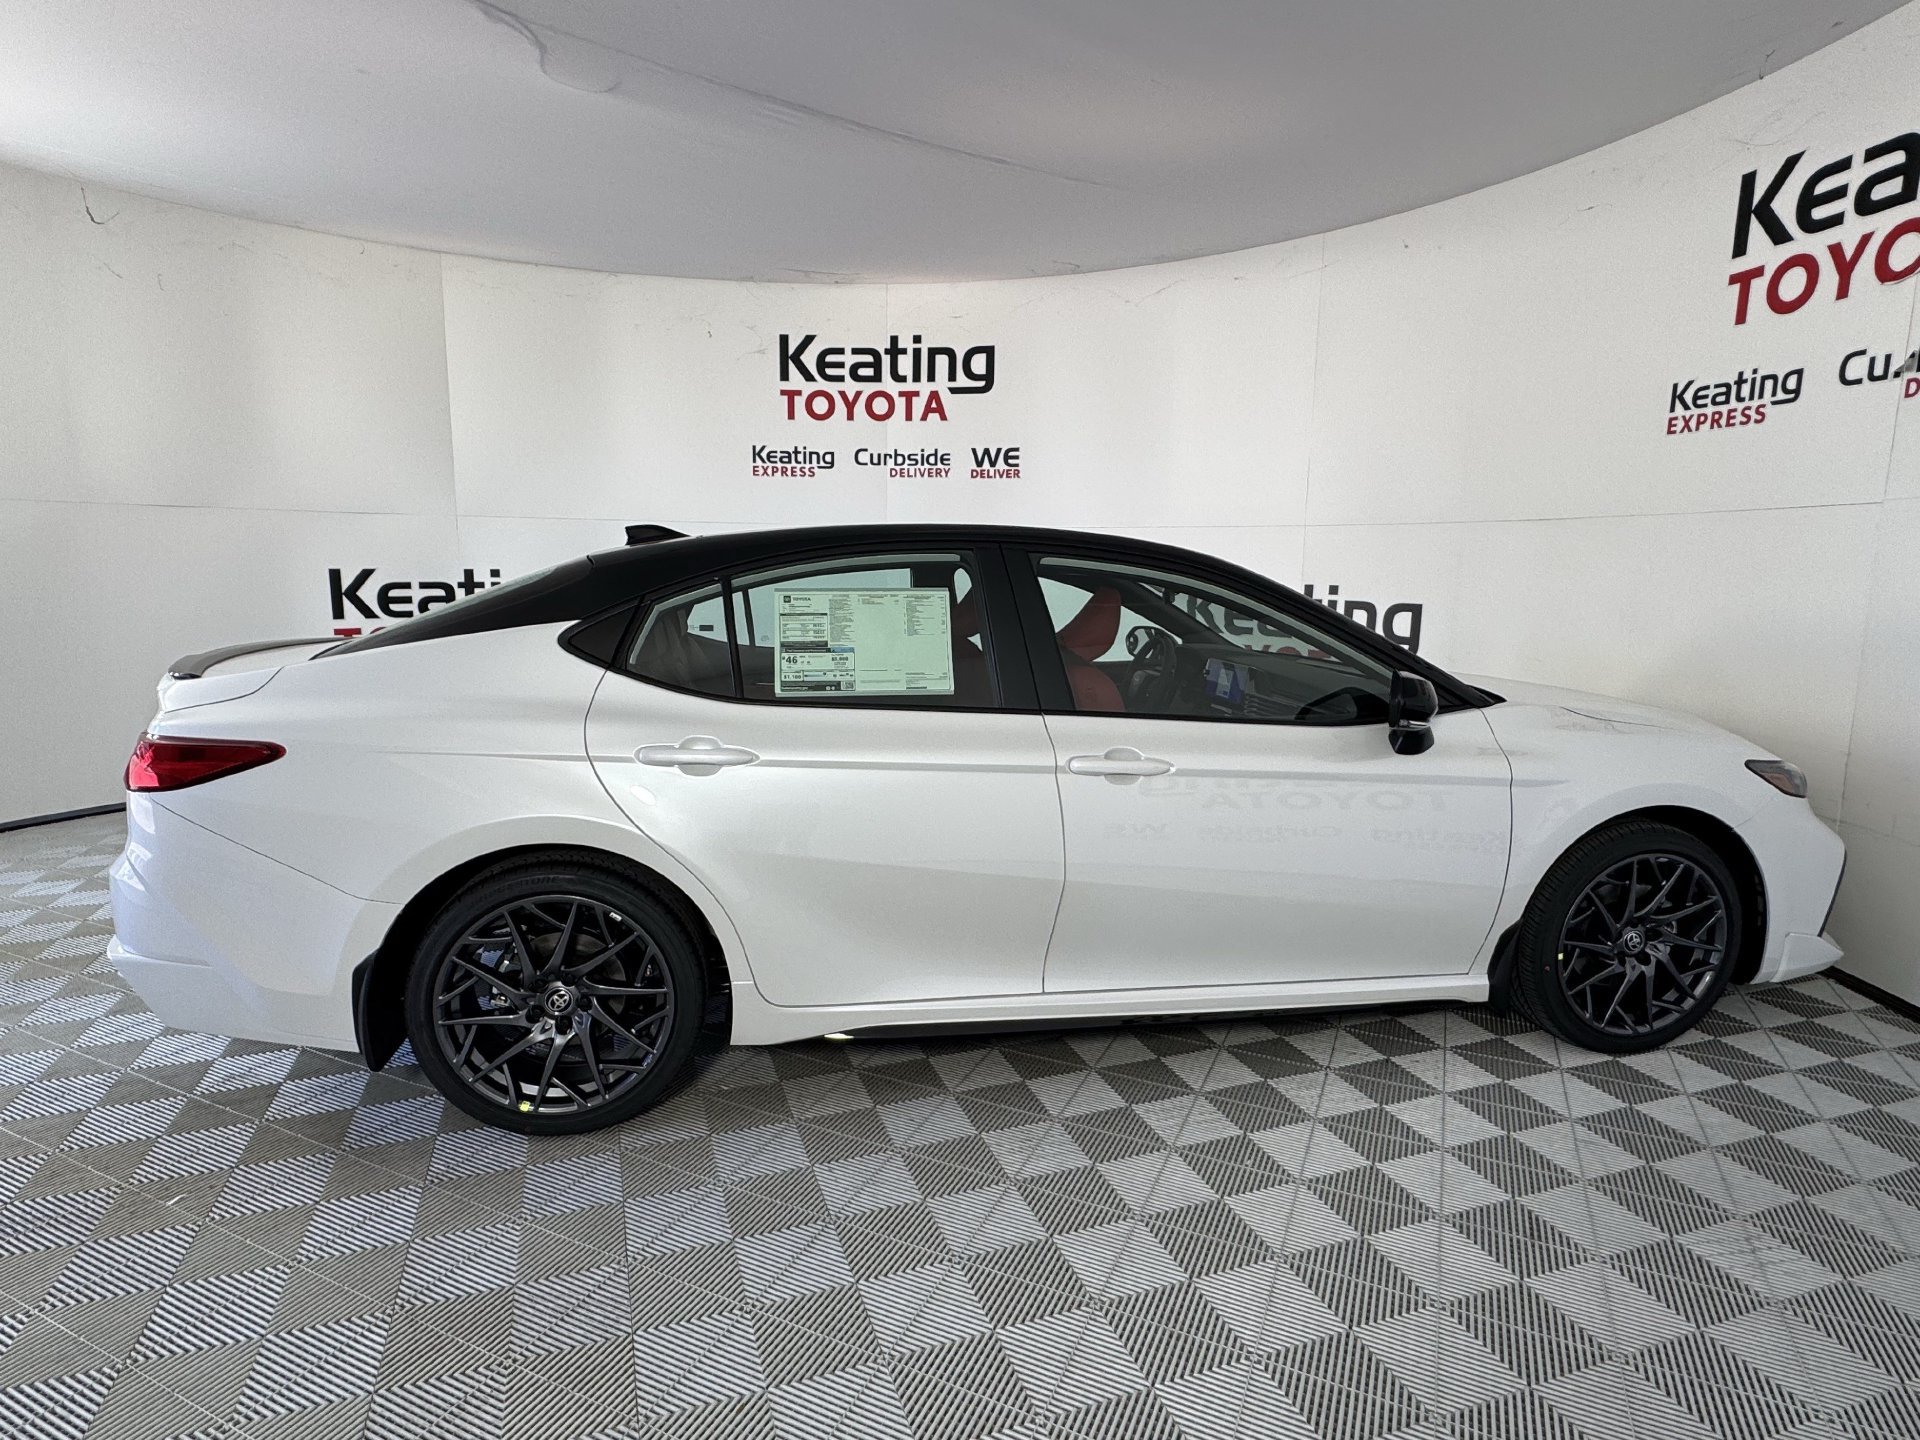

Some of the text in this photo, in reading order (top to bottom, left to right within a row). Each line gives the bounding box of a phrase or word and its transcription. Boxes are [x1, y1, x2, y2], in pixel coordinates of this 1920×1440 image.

[779, 334, 995, 394] Keating
[780, 389, 948, 422] TOYOTA
[1669, 368, 1804, 413] Keating
[1666, 403, 1767, 435] EXPRESS
[752, 445, 1020, 469] Keating Curbside WE
[752, 466, 1021, 479] EXPRESS DELIVERY DELIVER
[785, 655, 798, 664] 46
